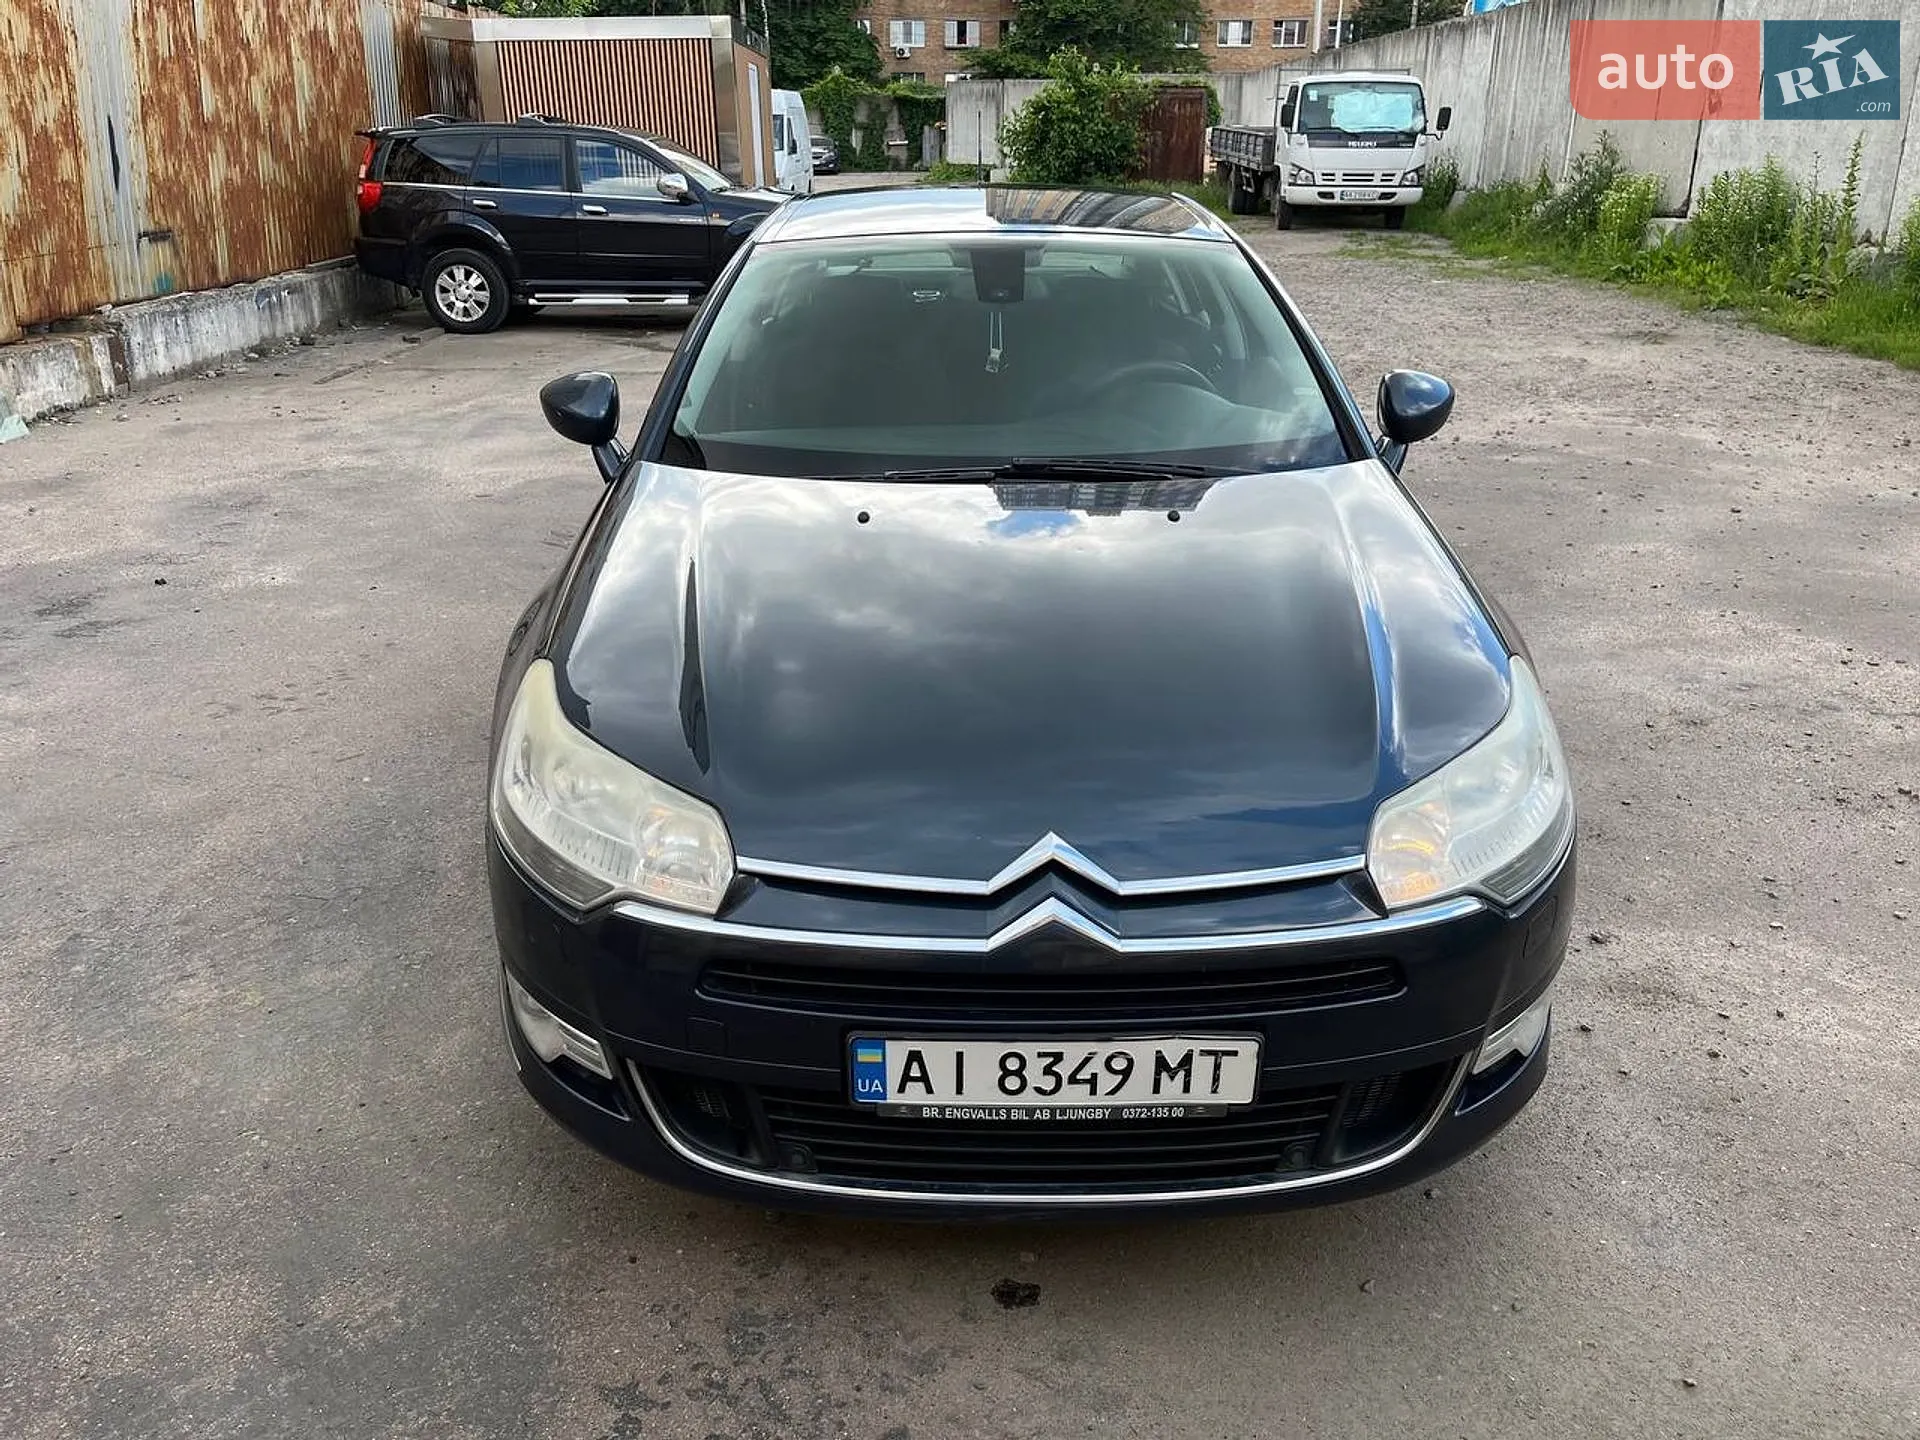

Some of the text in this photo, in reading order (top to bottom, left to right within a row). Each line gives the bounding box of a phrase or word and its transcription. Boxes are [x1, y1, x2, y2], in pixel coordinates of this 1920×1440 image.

[896, 1048, 1240, 1096] AI 8349 MT
[857, 1078, 884, 1093] UA
[922, 1106, 1185, 1120] BR. ENGVALLS BIL AB LJUNGBY 0372-135 00
